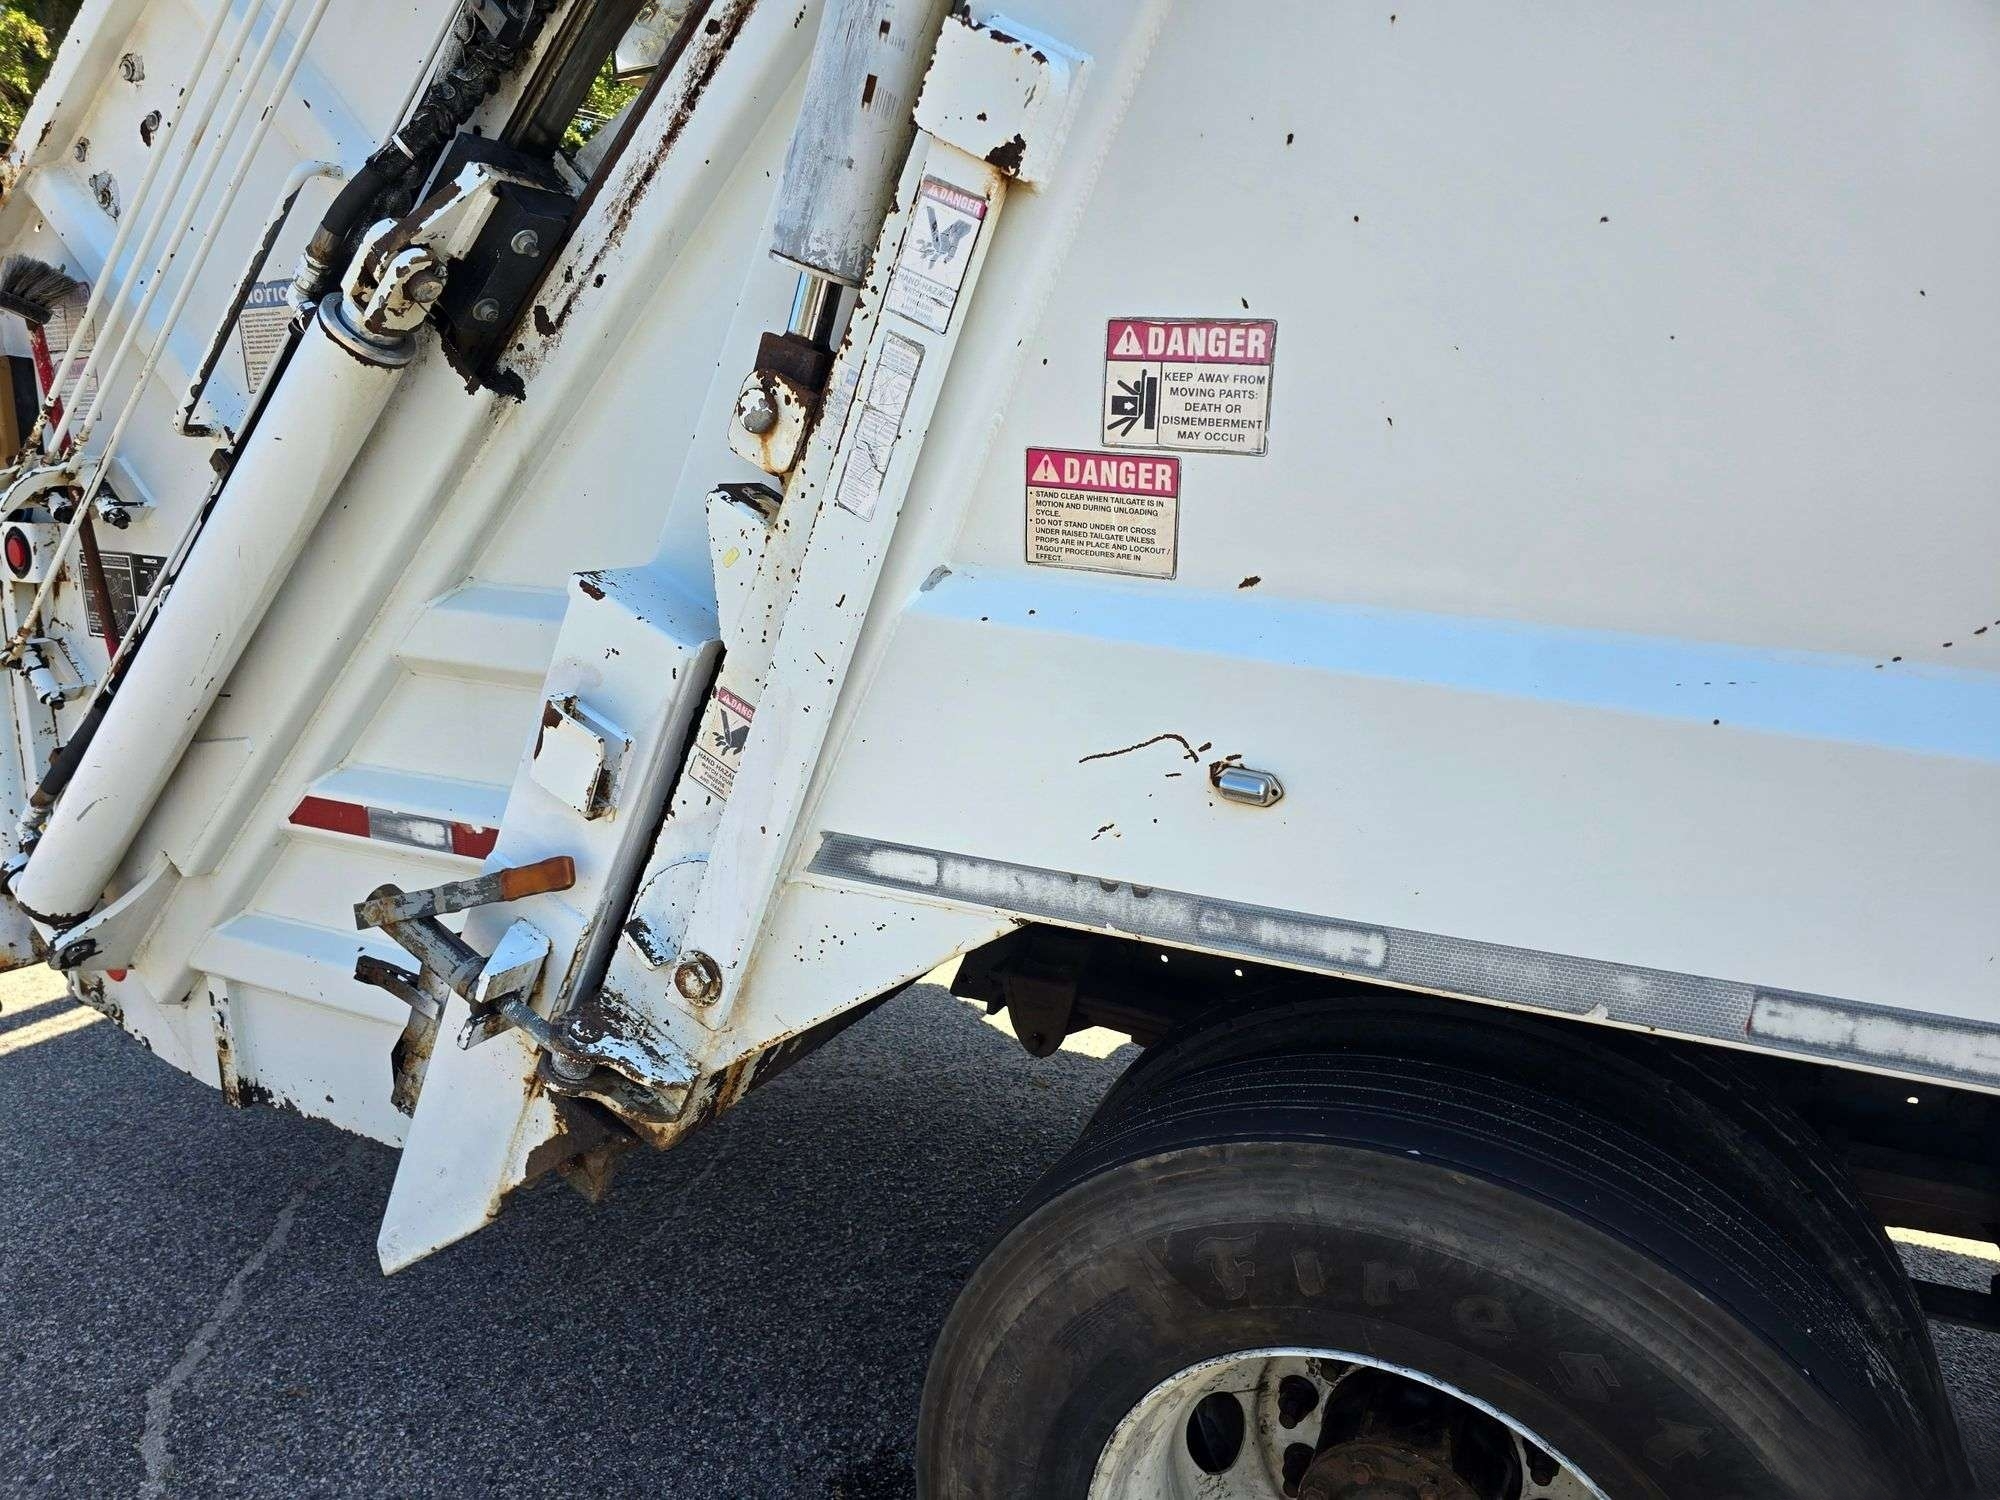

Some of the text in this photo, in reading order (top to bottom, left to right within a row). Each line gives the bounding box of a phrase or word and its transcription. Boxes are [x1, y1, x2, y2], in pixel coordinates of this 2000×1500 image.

[941, 187, 982, 218] DANGER
[246, 286, 288, 304] OTIC
[1147, 326, 1266, 358] DANGER
[1164, 372, 1266, 385] KEEP AWAY FROM
[1169, 387, 1258, 400] MOVING PARTS:
[1184, 402, 1242, 414] DEATH OR
[1162, 416, 1263, 429] DISMEMBERMENT
[1177, 431, 1246, 443] MAY OCCUR
[1063, 457, 1173, 491] DANGER
[1035, 491, 1059, 499] STAND
[1110, 496, 1146, 506] TAILGATE
[1035, 500, 1159, 516] MOTION AND DURING UNLOADING
[1035, 509, 1061, 517] CYCLE.
[1064, 521, 1088, 529] STAND
[1089, 523, 1115, 531] UNDER
[1130, 526, 1156, 535] CROSS
[1035, 527, 1155, 544] UNDER RAISED TAILGATE UNLESS
[1035, 536, 1059, 544] PROPS
[1085, 541, 1110, 549] PLACE
[1129, 545, 1166, 554] LOCKOUT
[1035, 544, 1064, 553] TAGOUT
[1065, 547, 1115, 558] PROCEDURES
[1116, 552, 1132, 560] ARE
[1035, 553, 1063, 561] EFFECT.
[698, 752, 715, 766] HAND
